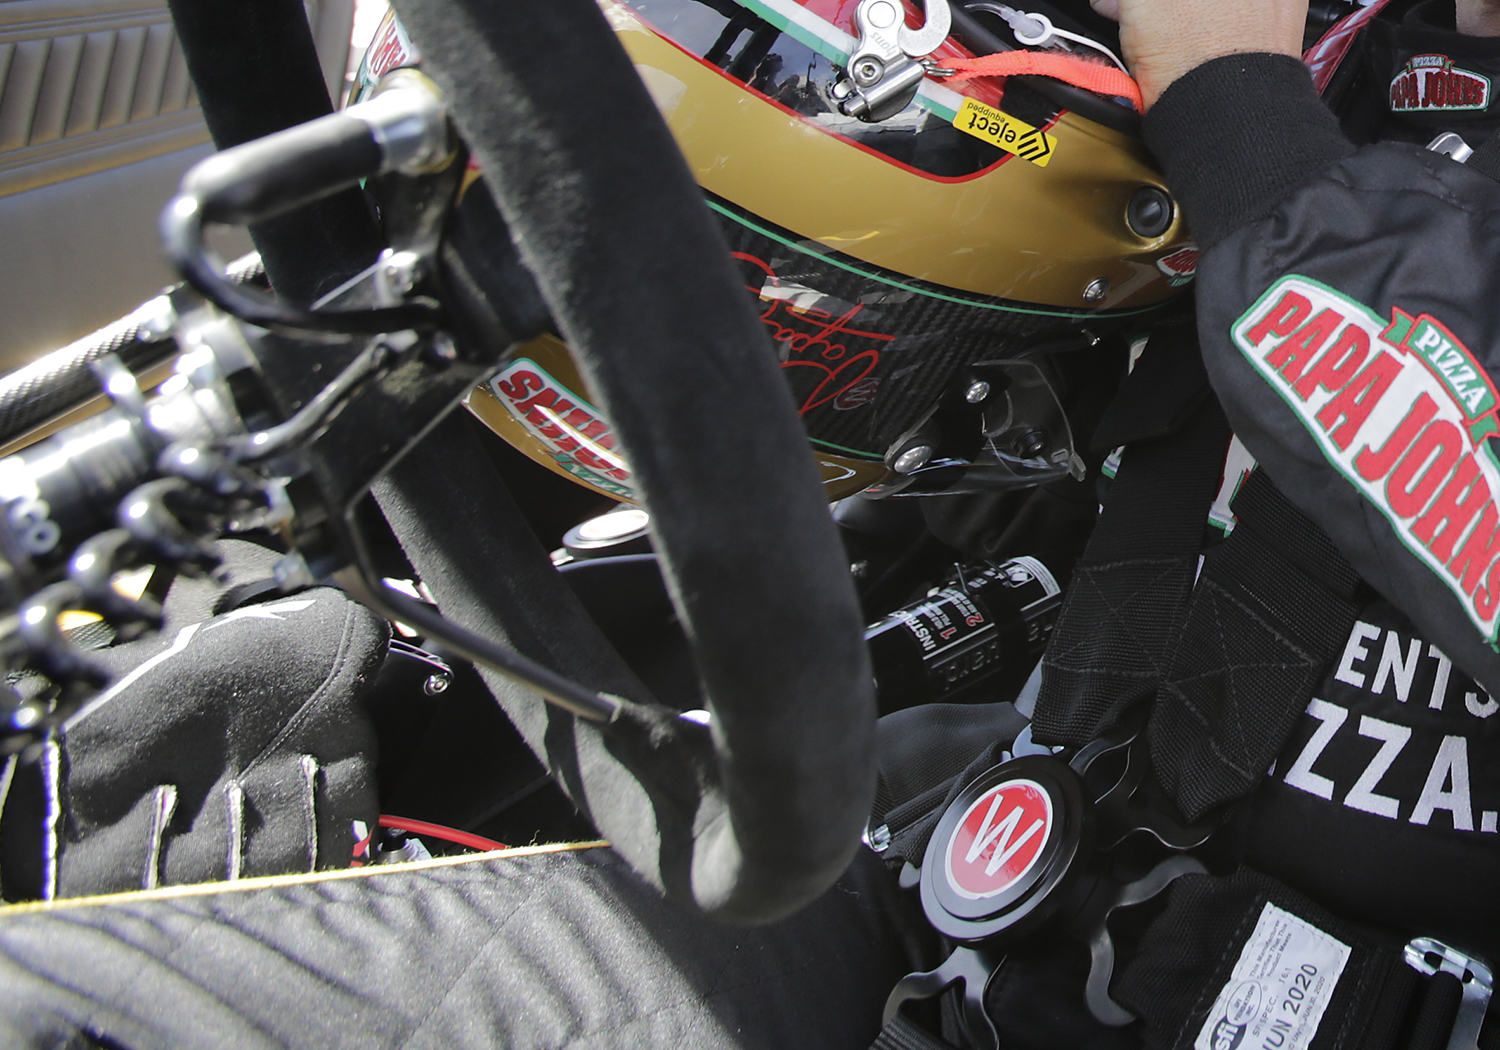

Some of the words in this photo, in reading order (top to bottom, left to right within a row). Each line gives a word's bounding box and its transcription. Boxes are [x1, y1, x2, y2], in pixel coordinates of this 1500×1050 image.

[869, 31, 897, 58] hans
[966, 102, 1006, 124] equipped
[968, 112, 1017, 143] eject
[1245, 290, 1404, 454] PAPA
[1414, 324, 1487, 414] PIZZA
[940, 626, 957, 640] 1
[966, 612, 984, 627] 2
[1268, 697, 1498, 834] ZZA.
[965, 793, 1045, 878] W
[1282, 963, 1318, 1015] 2020
